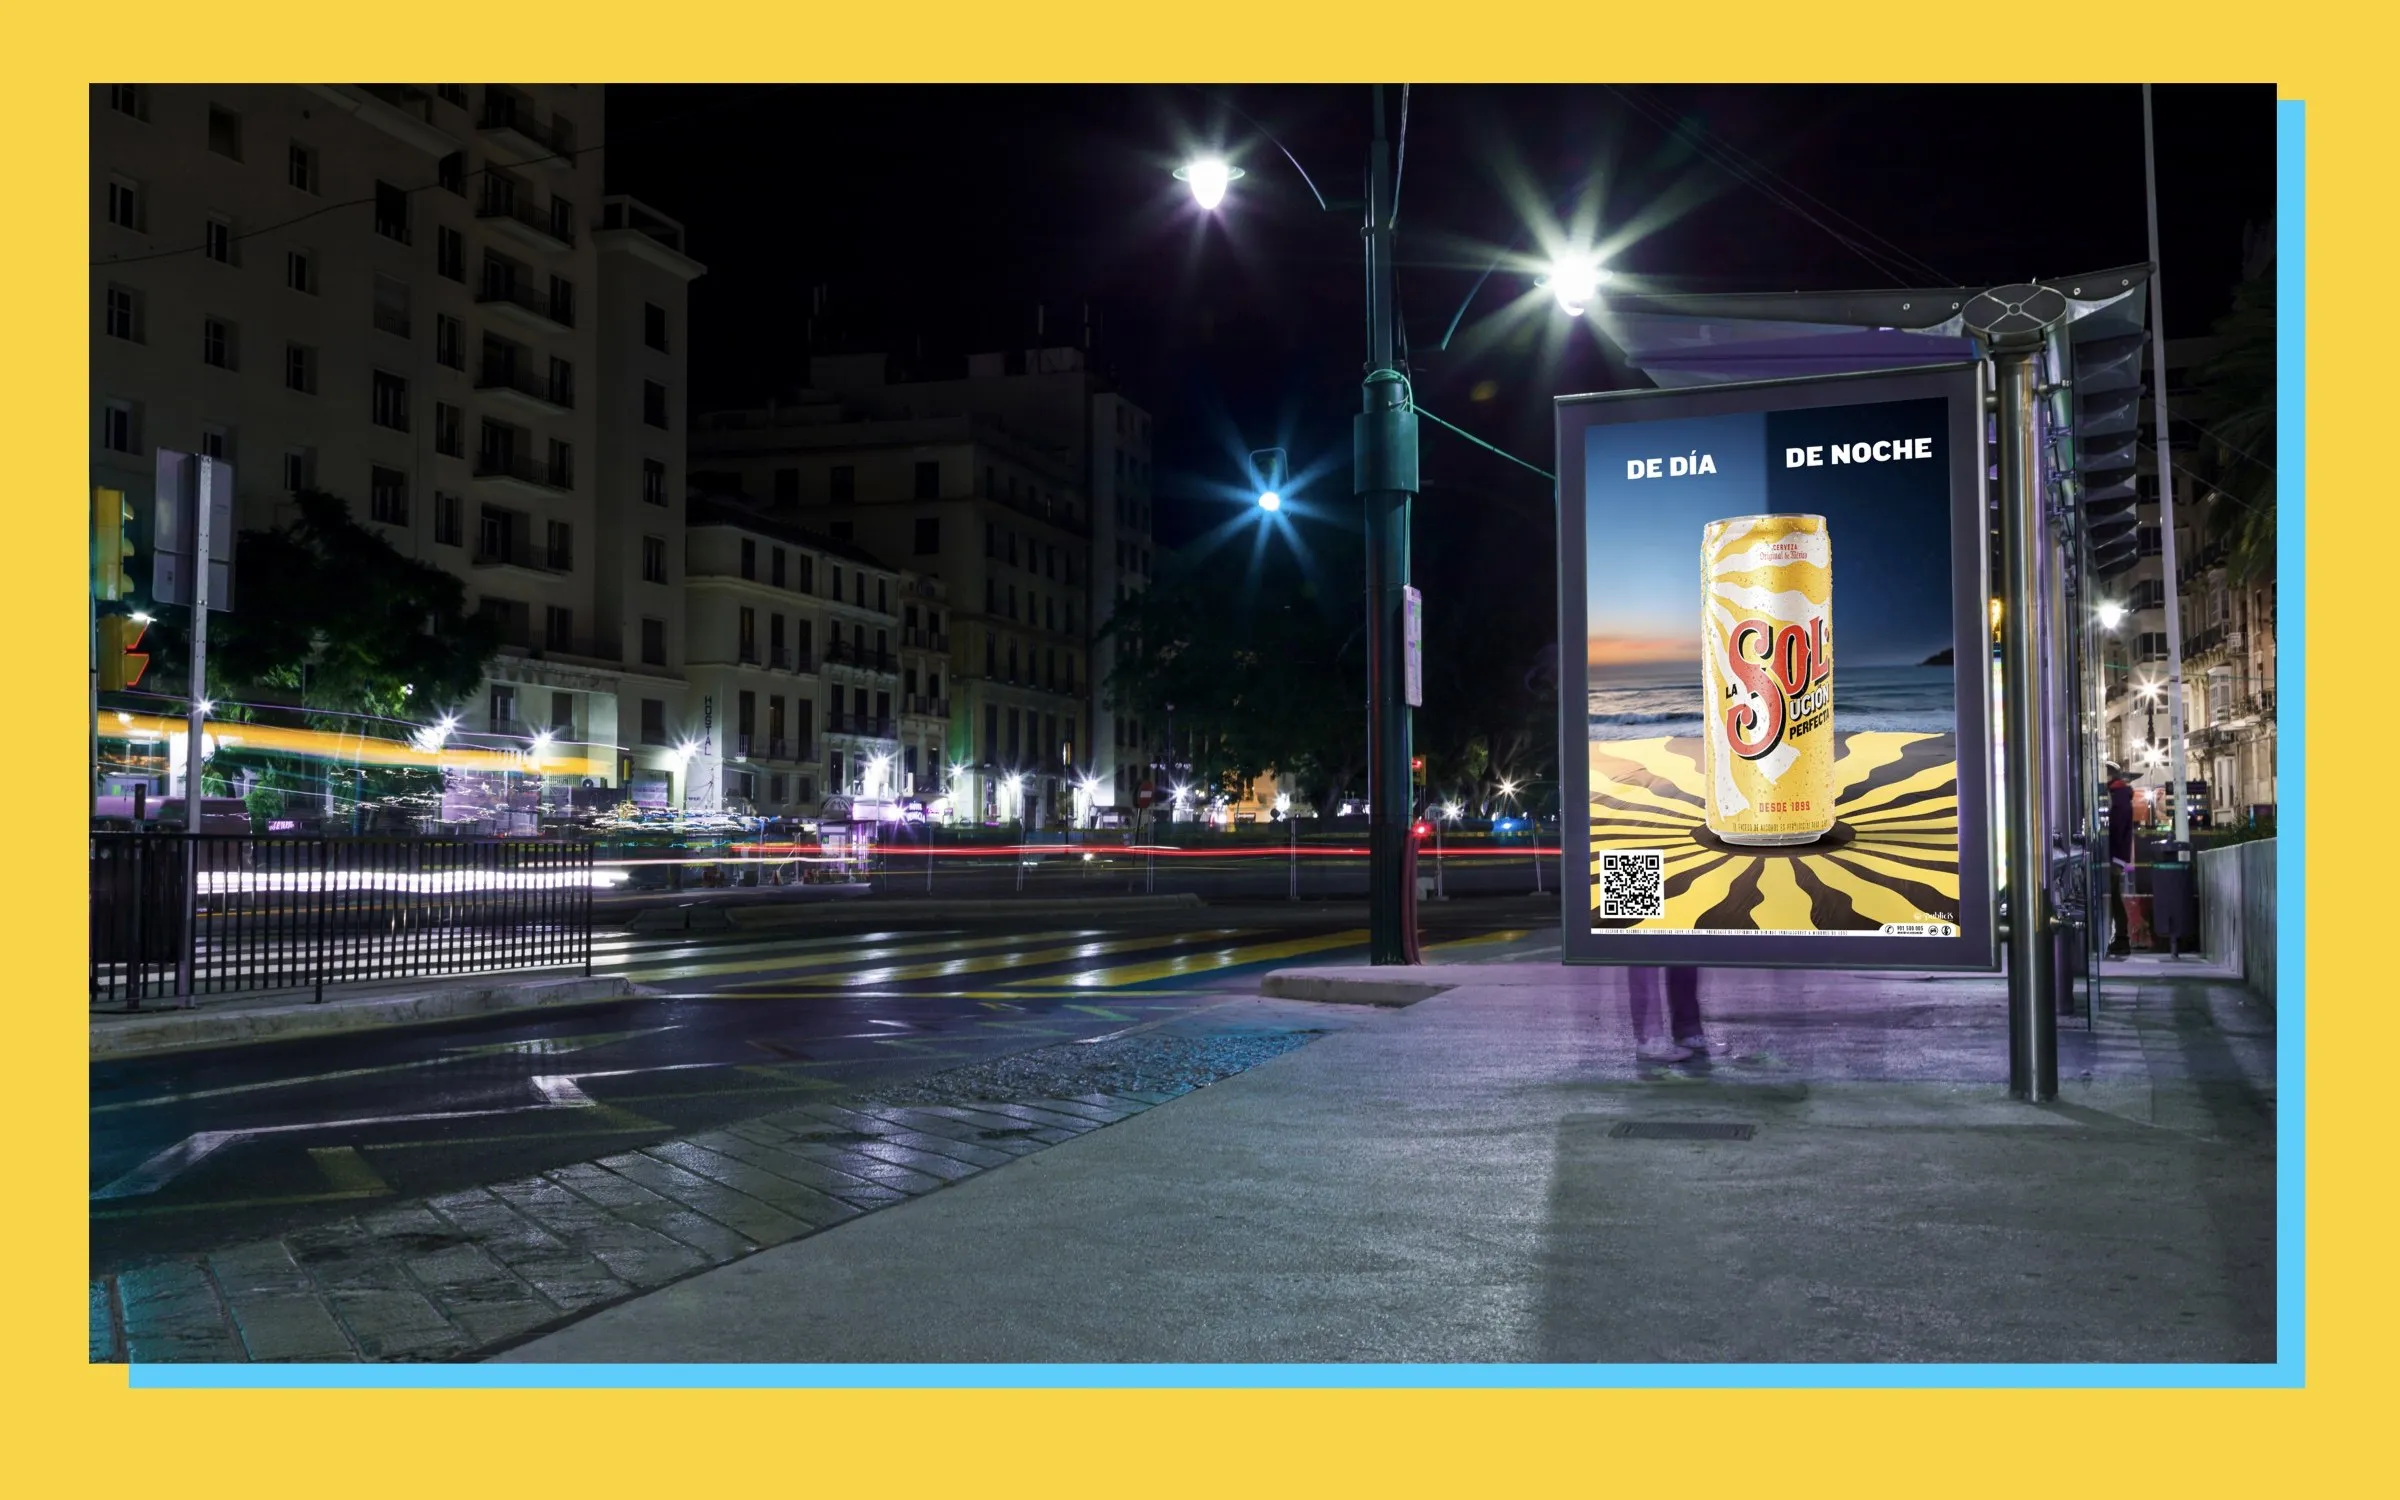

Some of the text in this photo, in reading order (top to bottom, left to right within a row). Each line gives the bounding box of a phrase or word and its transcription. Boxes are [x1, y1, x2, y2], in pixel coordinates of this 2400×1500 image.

[1627, 450, 1717, 480] DE DÍA
[1786, 437, 1933, 468] DE NOCHE
[1772, 543, 1798, 551] CERVEZA
[1726, 683, 1738, 699] LA
[1789, 683, 1830, 721] UCIÓN
[704, 695, 713, 756] HOSTAL
[1789, 709, 1830, 740] PERFECTA
[1759, 801, 1811, 813] DESDE 1899
